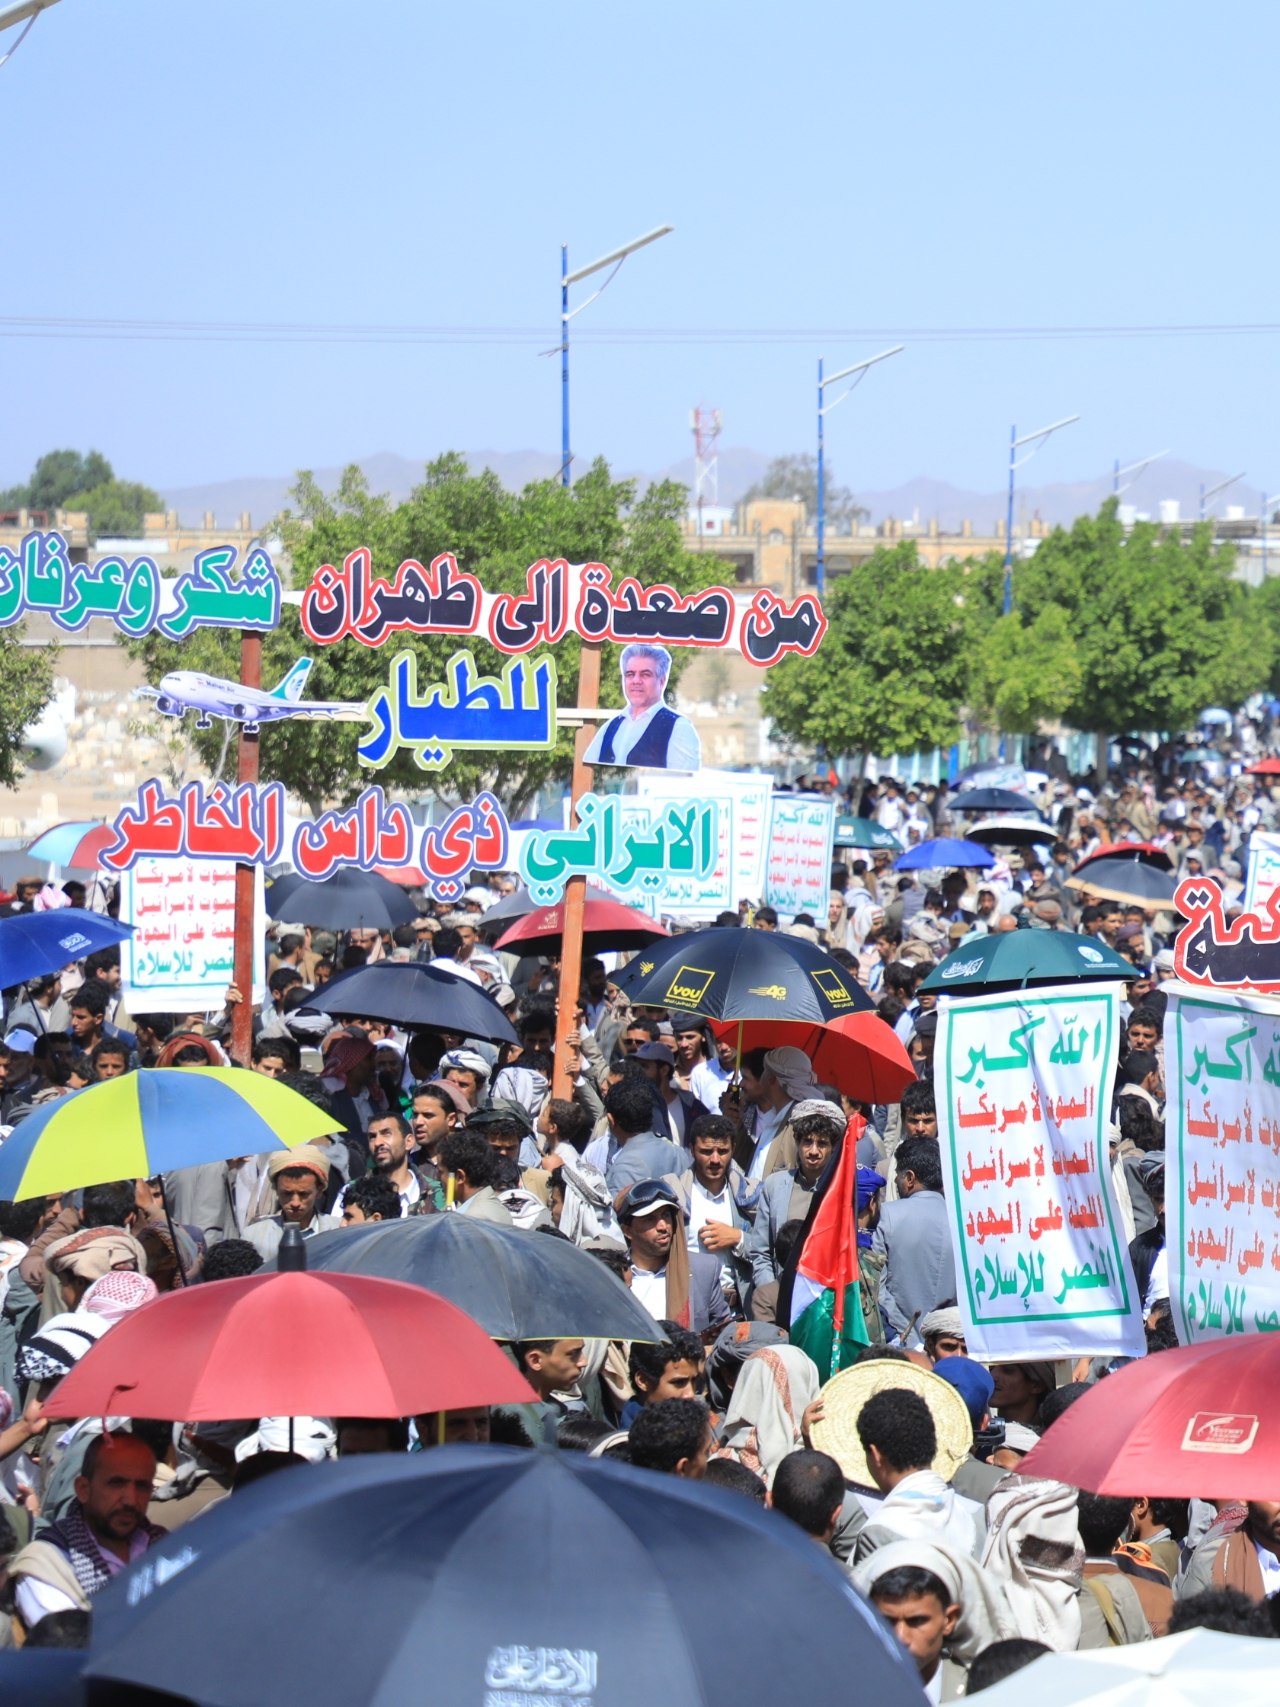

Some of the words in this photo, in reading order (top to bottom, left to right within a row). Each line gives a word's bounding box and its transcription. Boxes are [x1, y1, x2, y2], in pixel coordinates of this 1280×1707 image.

[162, 548, 276, 636] شكر
[308, 552, 477, 642] طهران
[580, 568, 731, 642] صعدة
[745, 593, 823, 663] من
[358, 656, 550, 763] للطيار
[102, 785, 279, 869] المخاطر
[299, 789, 408, 877] داس
[425, 797, 503, 895] ذي
[525, 800, 713, 898] الايراني
[200, 869, 237, 886] موت
[200, 897, 236, 915] موت
[200, 946, 235, 978] نصر
[673, 985, 701, 998] YOU
[955, 1010, 1046, 1089] أكبر
[1049, 1014, 1101, 1066] الله
[1185, 1016, 1257, 1095] أكبر
[957, 1082, 1042, 1134] لأمريكا
[1187, 1097, 1253, 1148] لأمريكا
[962, 1144, 1045, 1191] لإسرائيل
[1188, 1160, 1255, 1216] لإسرائيل
[966, 1200, 1022, 1245] اليهود
[1028, 1198, 1063, 1241] على
[1188, 1225, 1234, 1268] اليهود
[975, 1249, 1045, 1311] للإسلام
[1053, 1240, 1115, 1305] النصر
[1238, 1230, 1264, 1275] على
